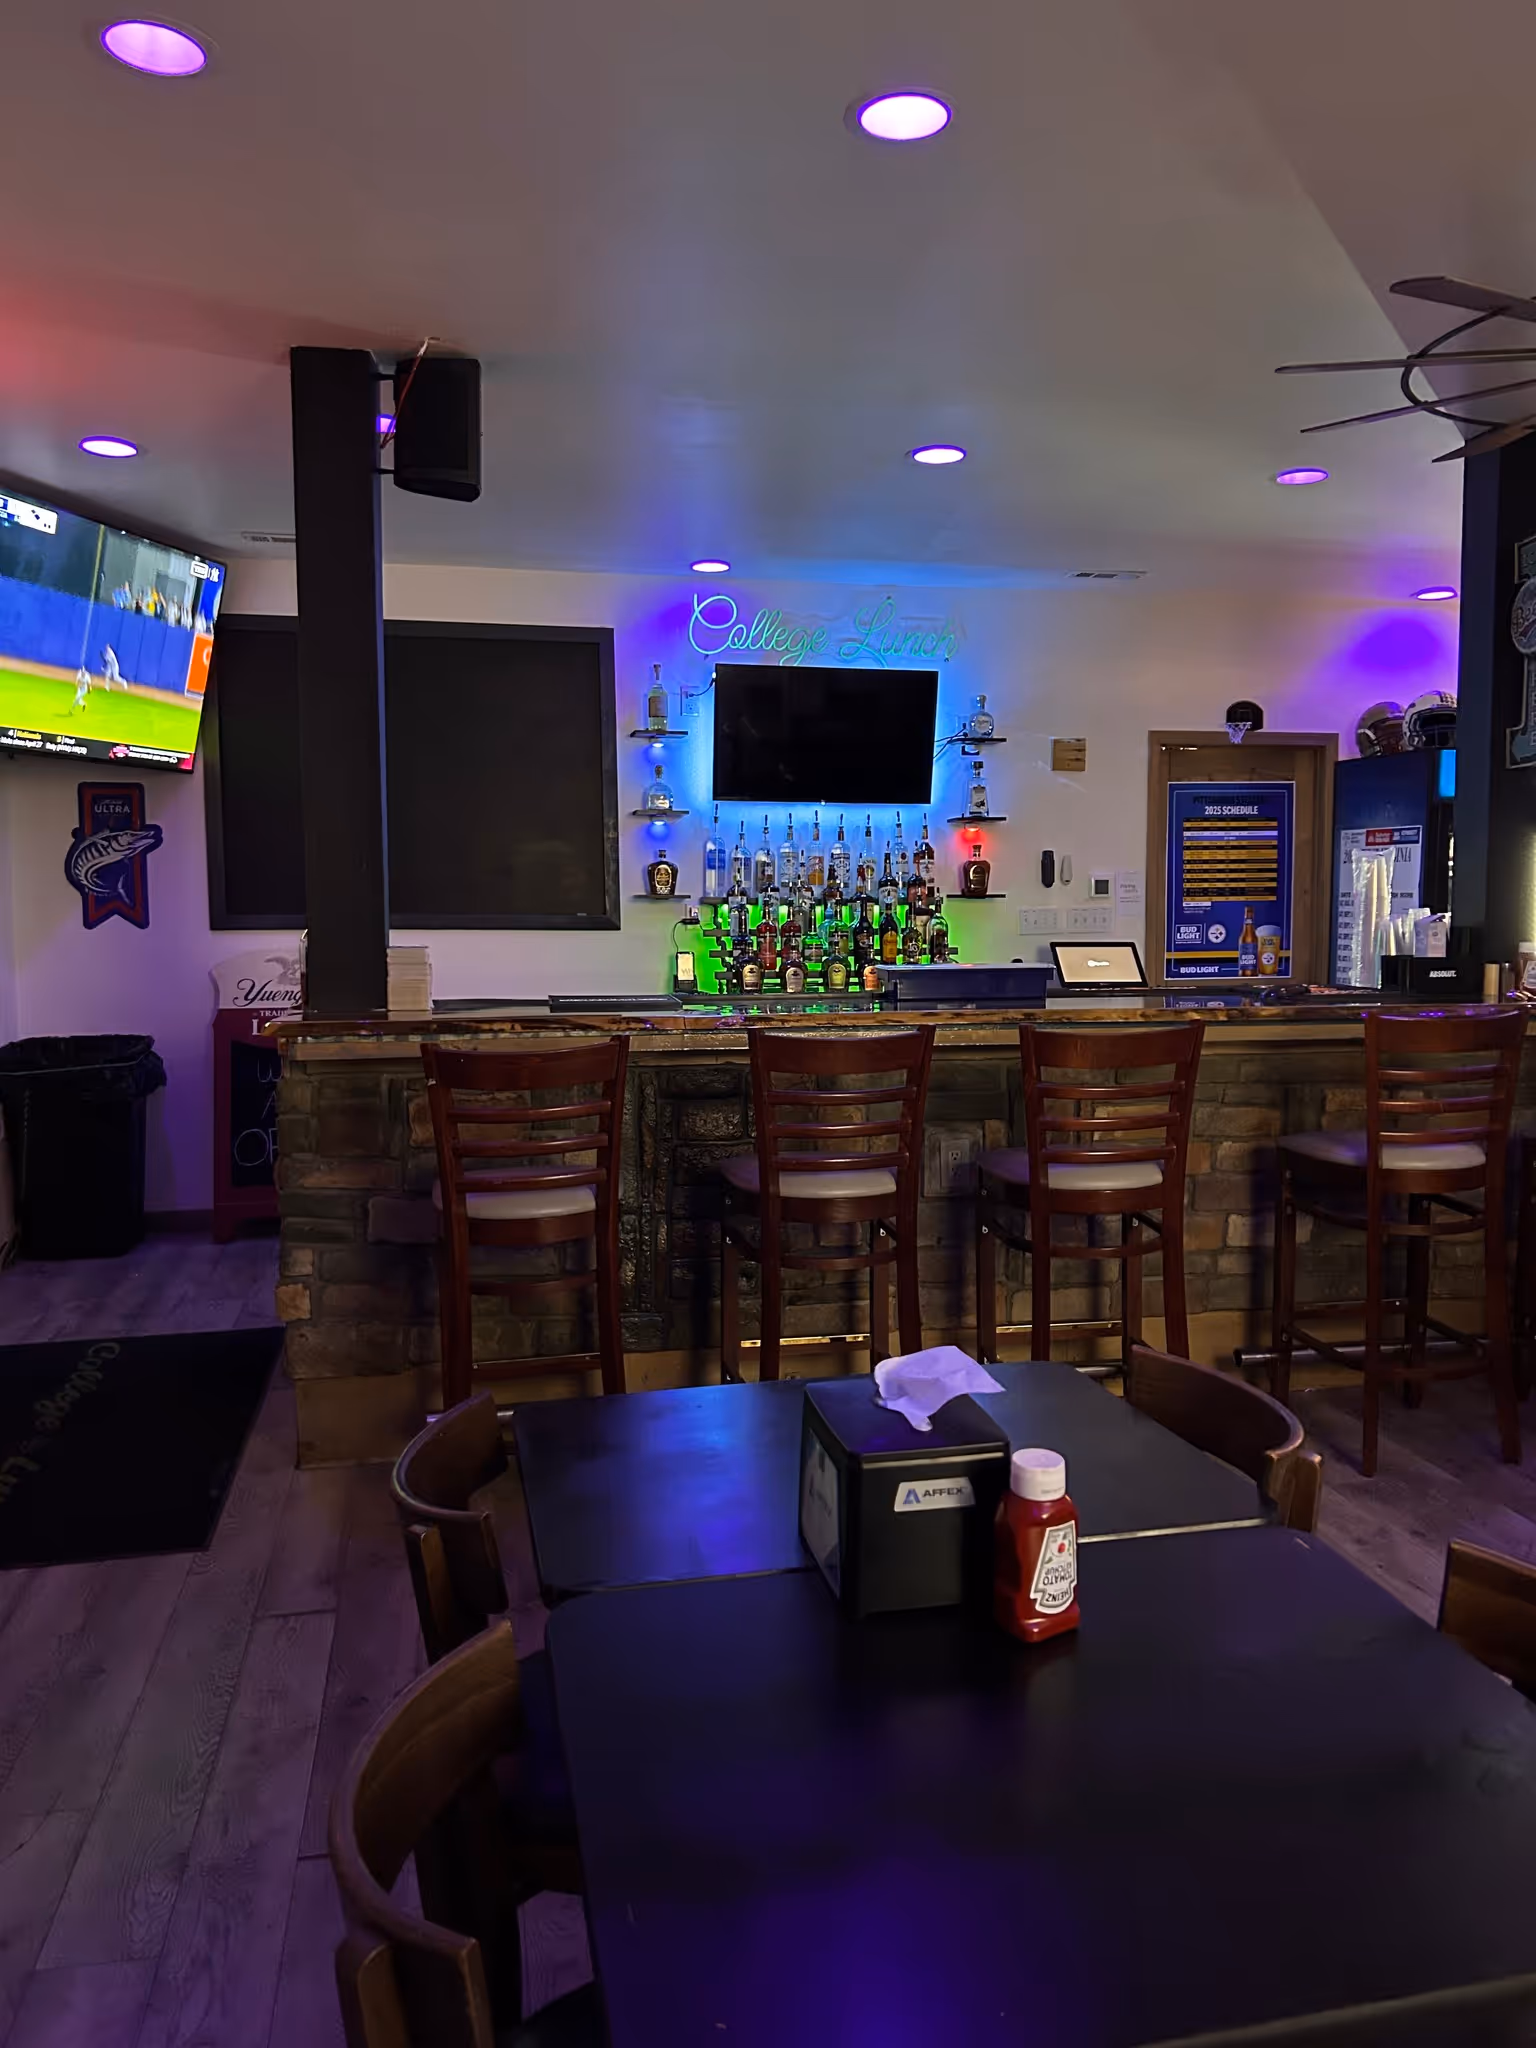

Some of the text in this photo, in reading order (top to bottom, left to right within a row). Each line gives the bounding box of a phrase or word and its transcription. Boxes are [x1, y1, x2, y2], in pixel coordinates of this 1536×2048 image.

[689, 594, 958, 668] College Lunch
[95, 804, 130, 813] ULTRA
[1205, 806, 1258, 814] 2025 SCHEDULE
[233, 978, 303, 1007] Yueng
[922, 1486, 965, 1498] AFFEX
[1045, 1587, 1069, 1602] HEINZ
